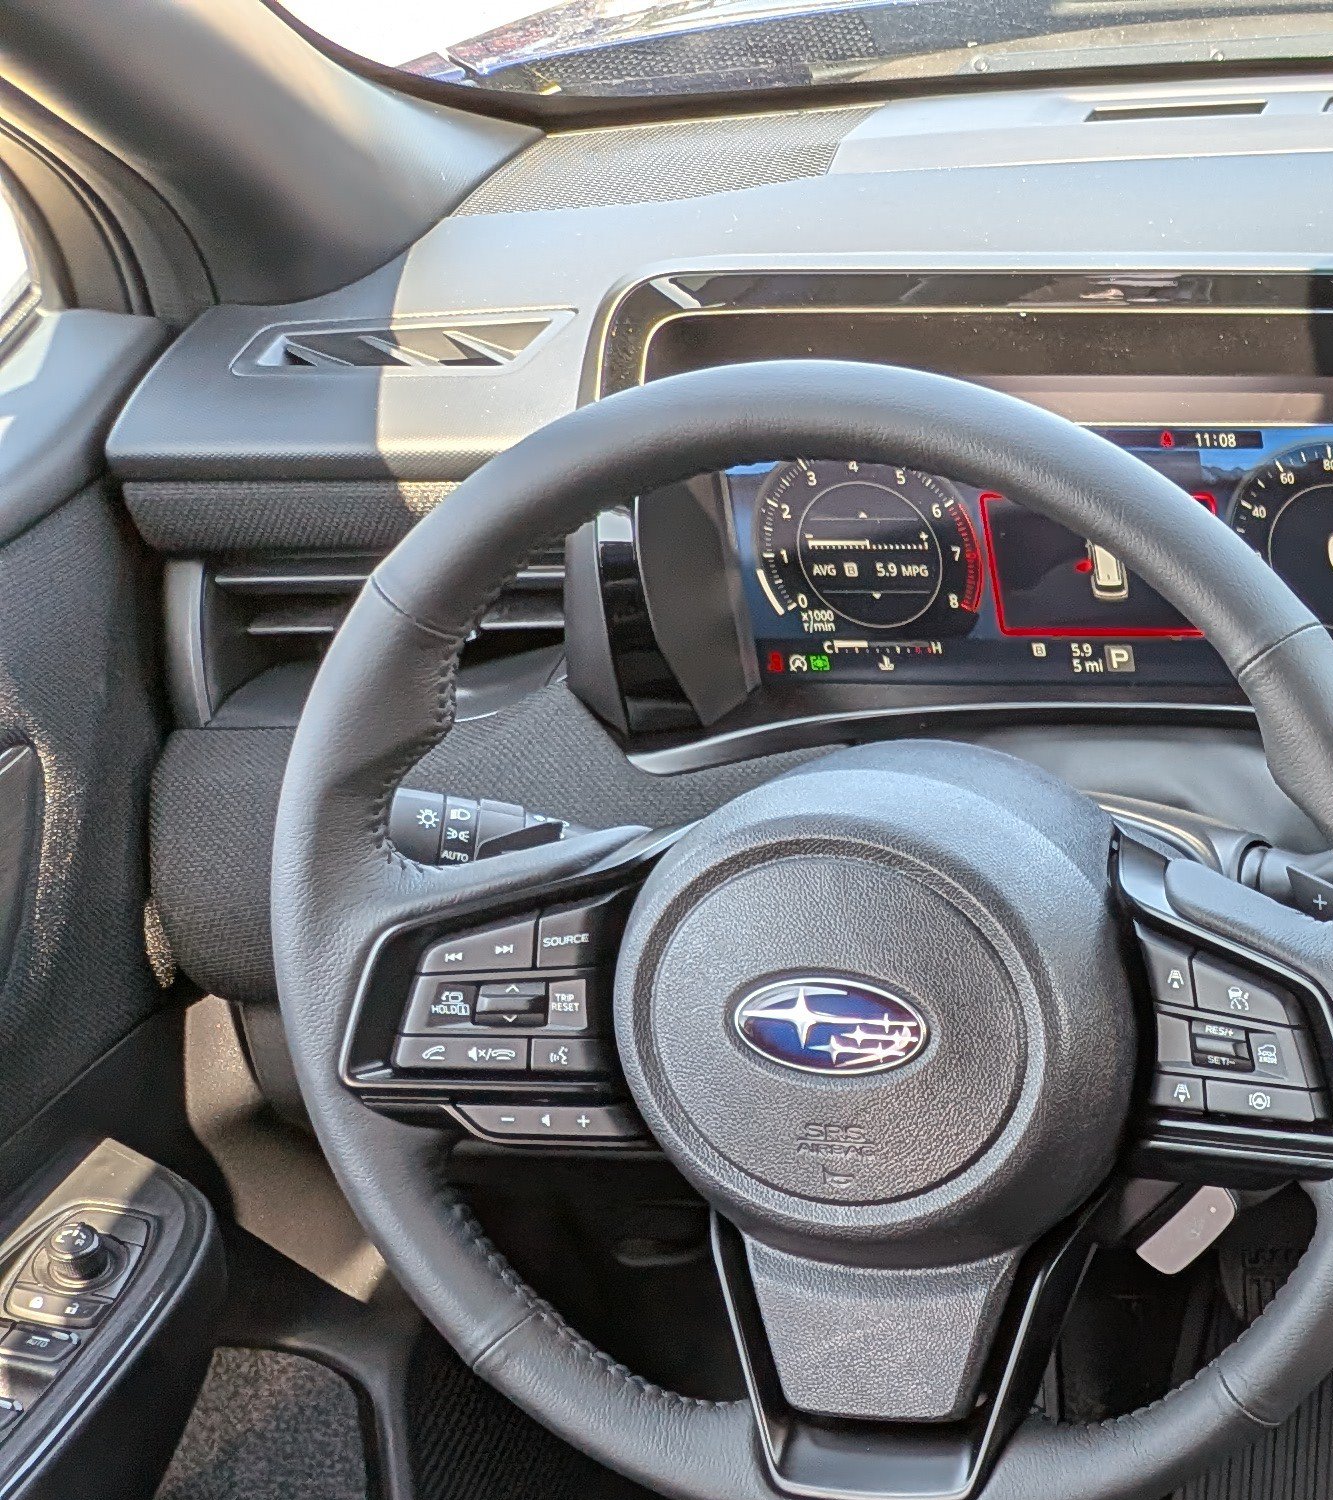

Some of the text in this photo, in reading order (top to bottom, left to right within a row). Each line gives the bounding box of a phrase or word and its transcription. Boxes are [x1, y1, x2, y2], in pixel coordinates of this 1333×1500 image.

[1194, 432, 1237, 448] 11:08
[848, 460, 859, 473] 4
[807, 471, 817, 486] 3
[895, 469, 906, 485] 5
[1279, 471, 1295, 485] 60
[780, 503, 792, 519] 2
[931, 504, 942, 519] 6
[1251, 504, 1267, 519] 40
[779, 549, 789, 564] 1
[951, 546, 961, 562] 7
[812, 563, 837, 578] AVG
[876, 562, 898, 578] 5.9
[902, 563, 929, 578] MPG
[797, 593, 808, 609] 0
[949, 593, 959, 609] 8
[801, 609, 835, 622] x1000
[803, 619, 836, 633] r/min
[822, 640, 834, 654] C
[930, 640, 943, 655] H
[1070, 642, 1093, 657] 5.9
[1072, 658, 1083, 673] 5
[1110, 648, 1129, 669] P
[440, 850, 469, 863] AUTO
[542, 933, 590, 948] SOURCE
[555, 993, 575, 1002] TRIP
[551, 1002, 580, 1012] RESET
[803, 1122, 867, 1142] SRS
